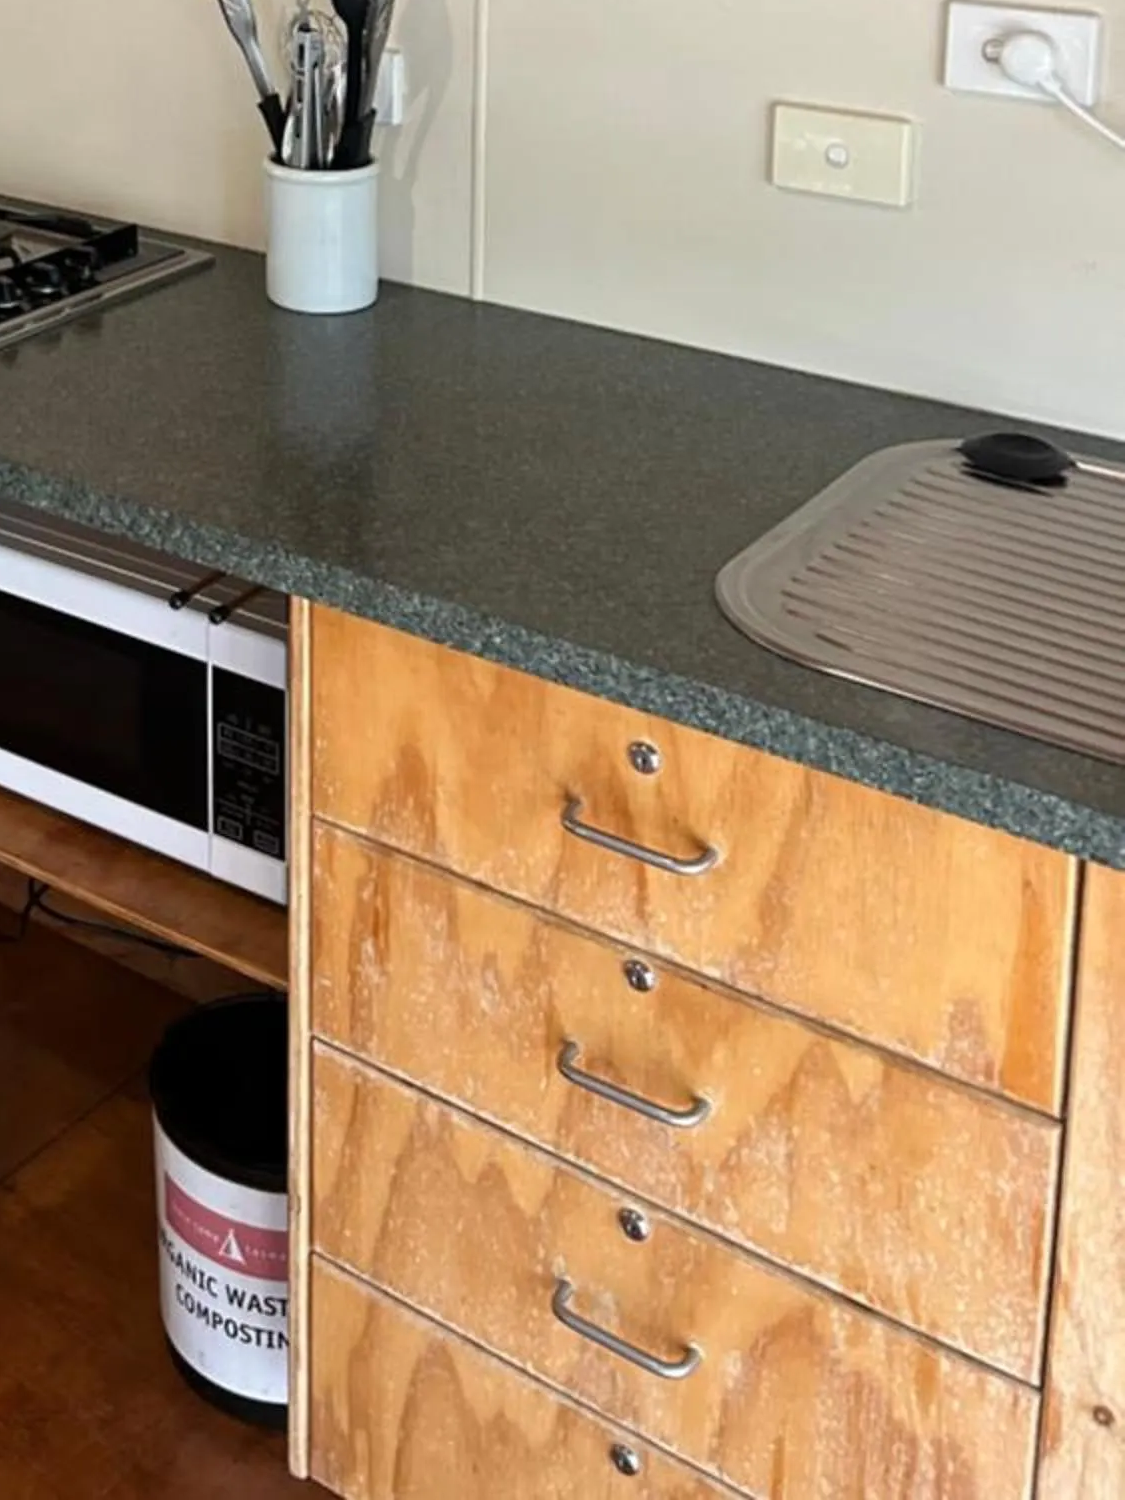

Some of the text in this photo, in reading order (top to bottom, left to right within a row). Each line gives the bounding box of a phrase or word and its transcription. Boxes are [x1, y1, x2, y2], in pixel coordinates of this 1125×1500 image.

[159, 1228, 289, 1317] RGANIC WAST
[175, 1283, 290, 1349] COMPOSTIN
